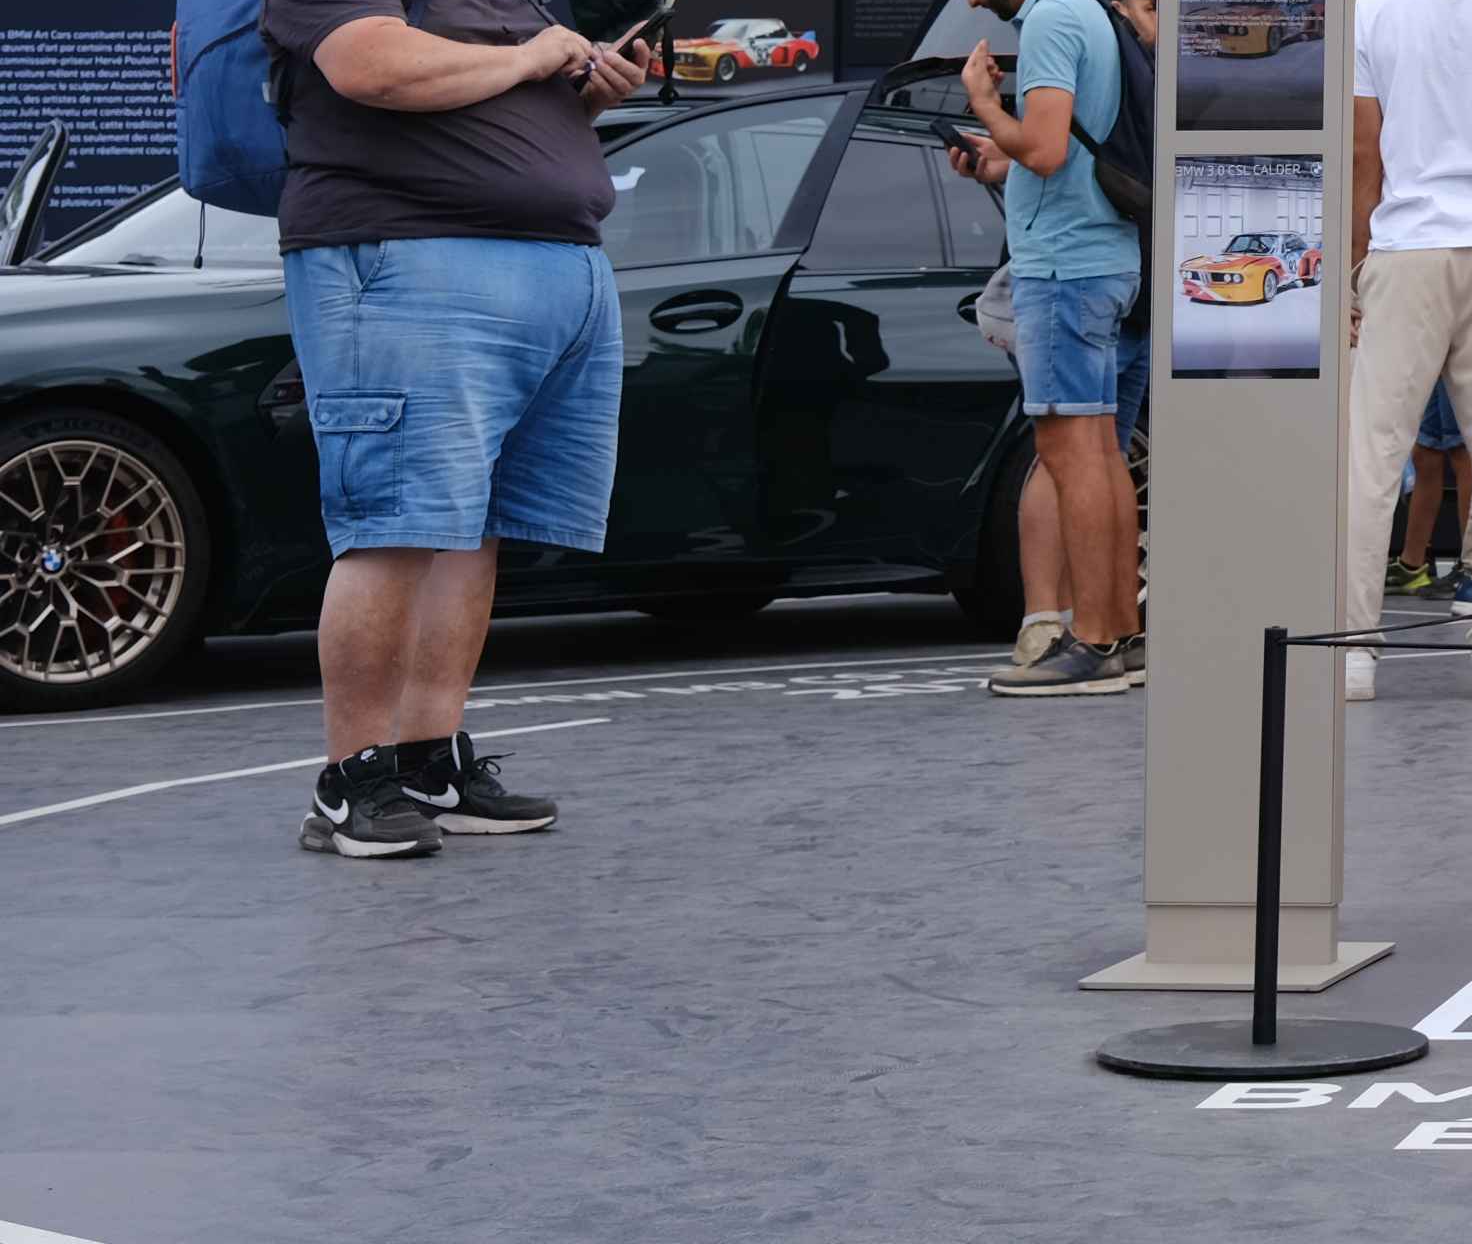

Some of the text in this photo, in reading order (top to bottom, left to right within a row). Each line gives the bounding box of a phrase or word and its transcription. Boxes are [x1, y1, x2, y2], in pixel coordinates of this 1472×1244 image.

[7, 30, 33, 40] BMW
[34, 30, 49, 40] Art
[51, 30, 72, 40] Cars
[127, 32, 145, 40] une
[124, 56, 160, 66] Poulain
[110, 82, 155, 92] Alexander
[1175, 163, 1301, 177] BMW 3.0 CSL CALDER
